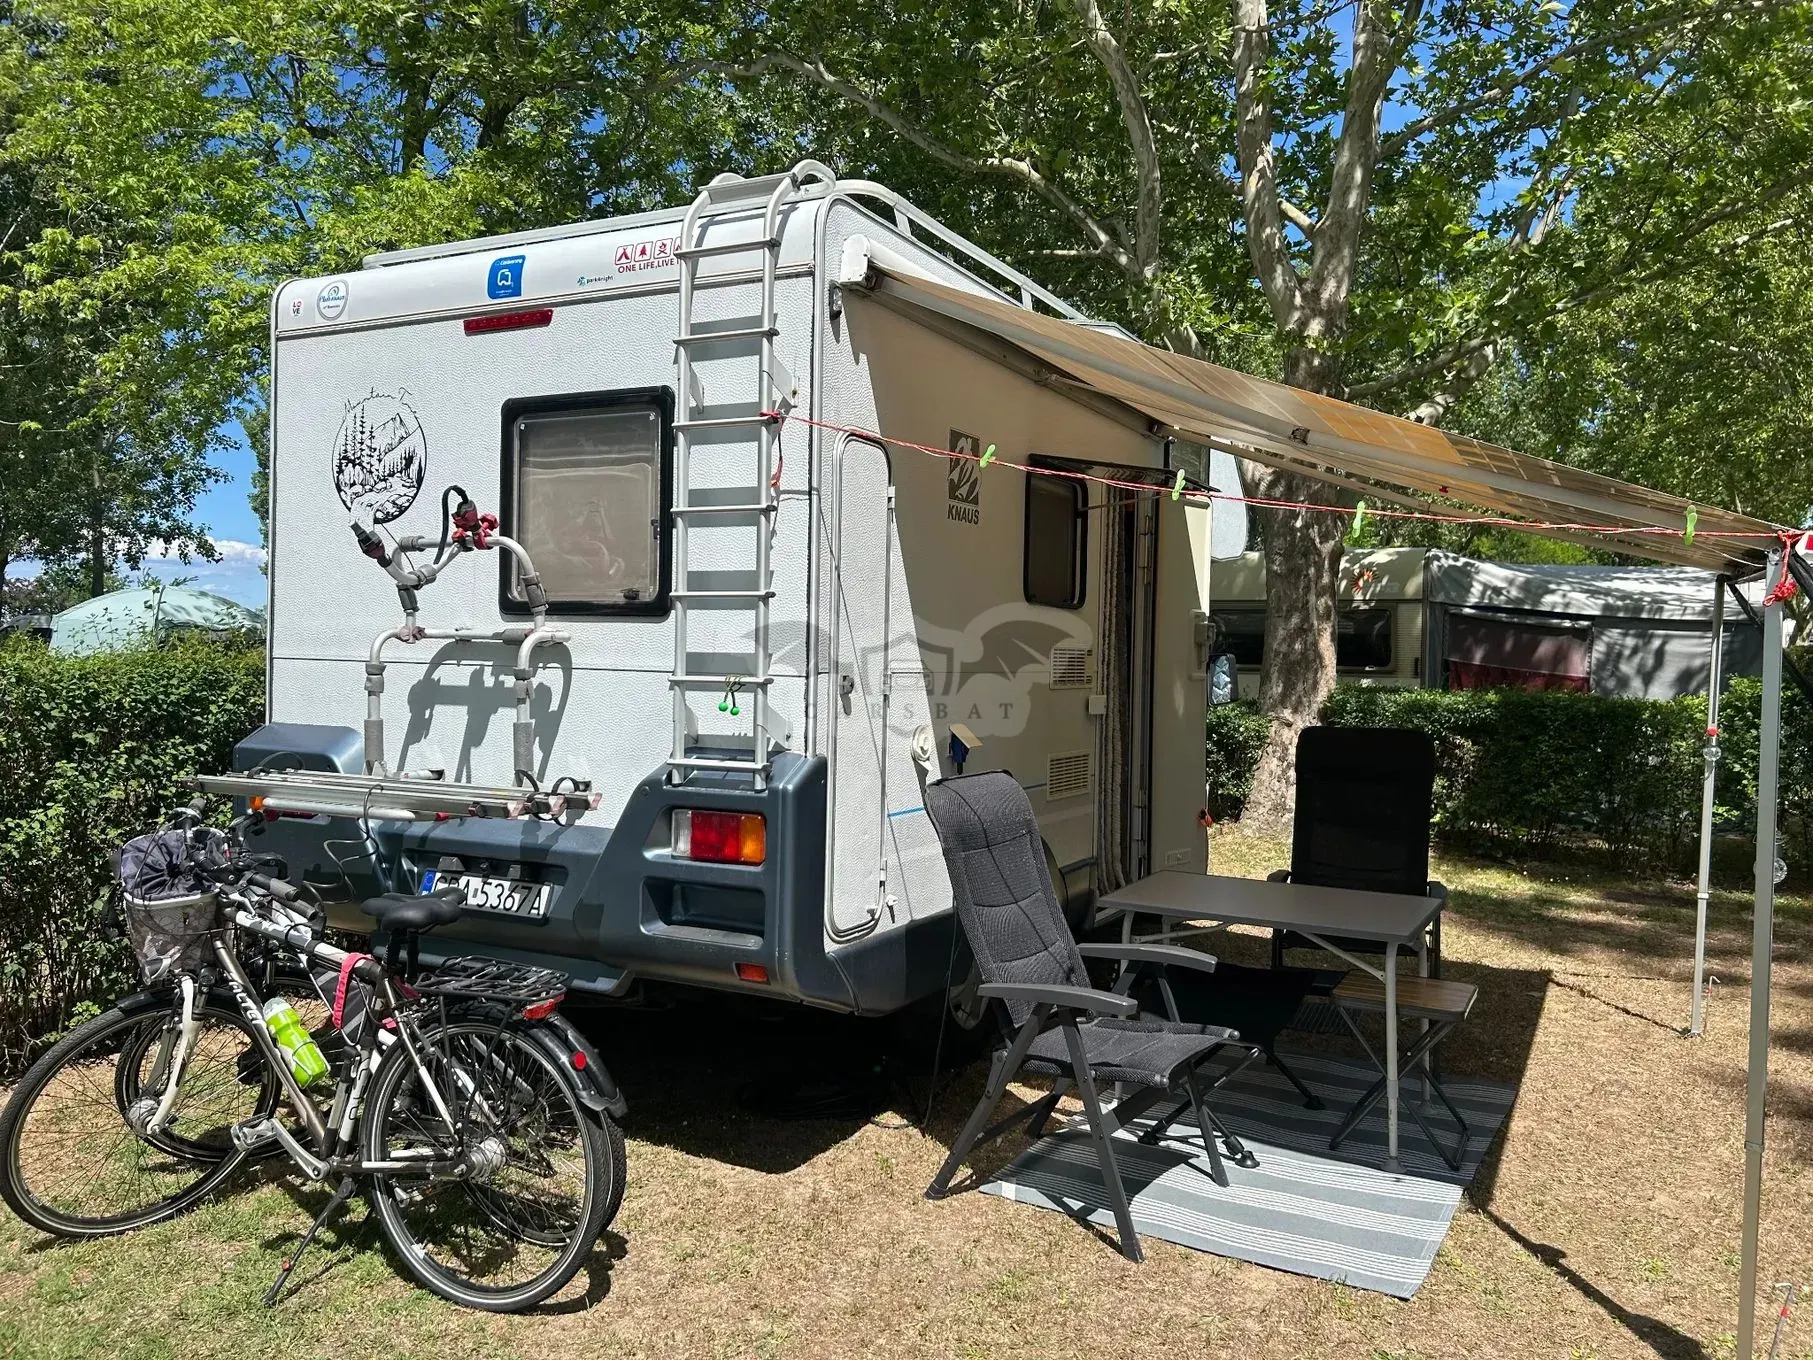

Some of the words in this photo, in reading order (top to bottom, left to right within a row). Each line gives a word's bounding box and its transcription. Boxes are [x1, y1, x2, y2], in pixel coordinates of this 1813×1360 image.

[618, 264, 636, 274] ONE
[948, 504, 980, 525] KNAUS
[476, 881, 543, 916] 5367A
